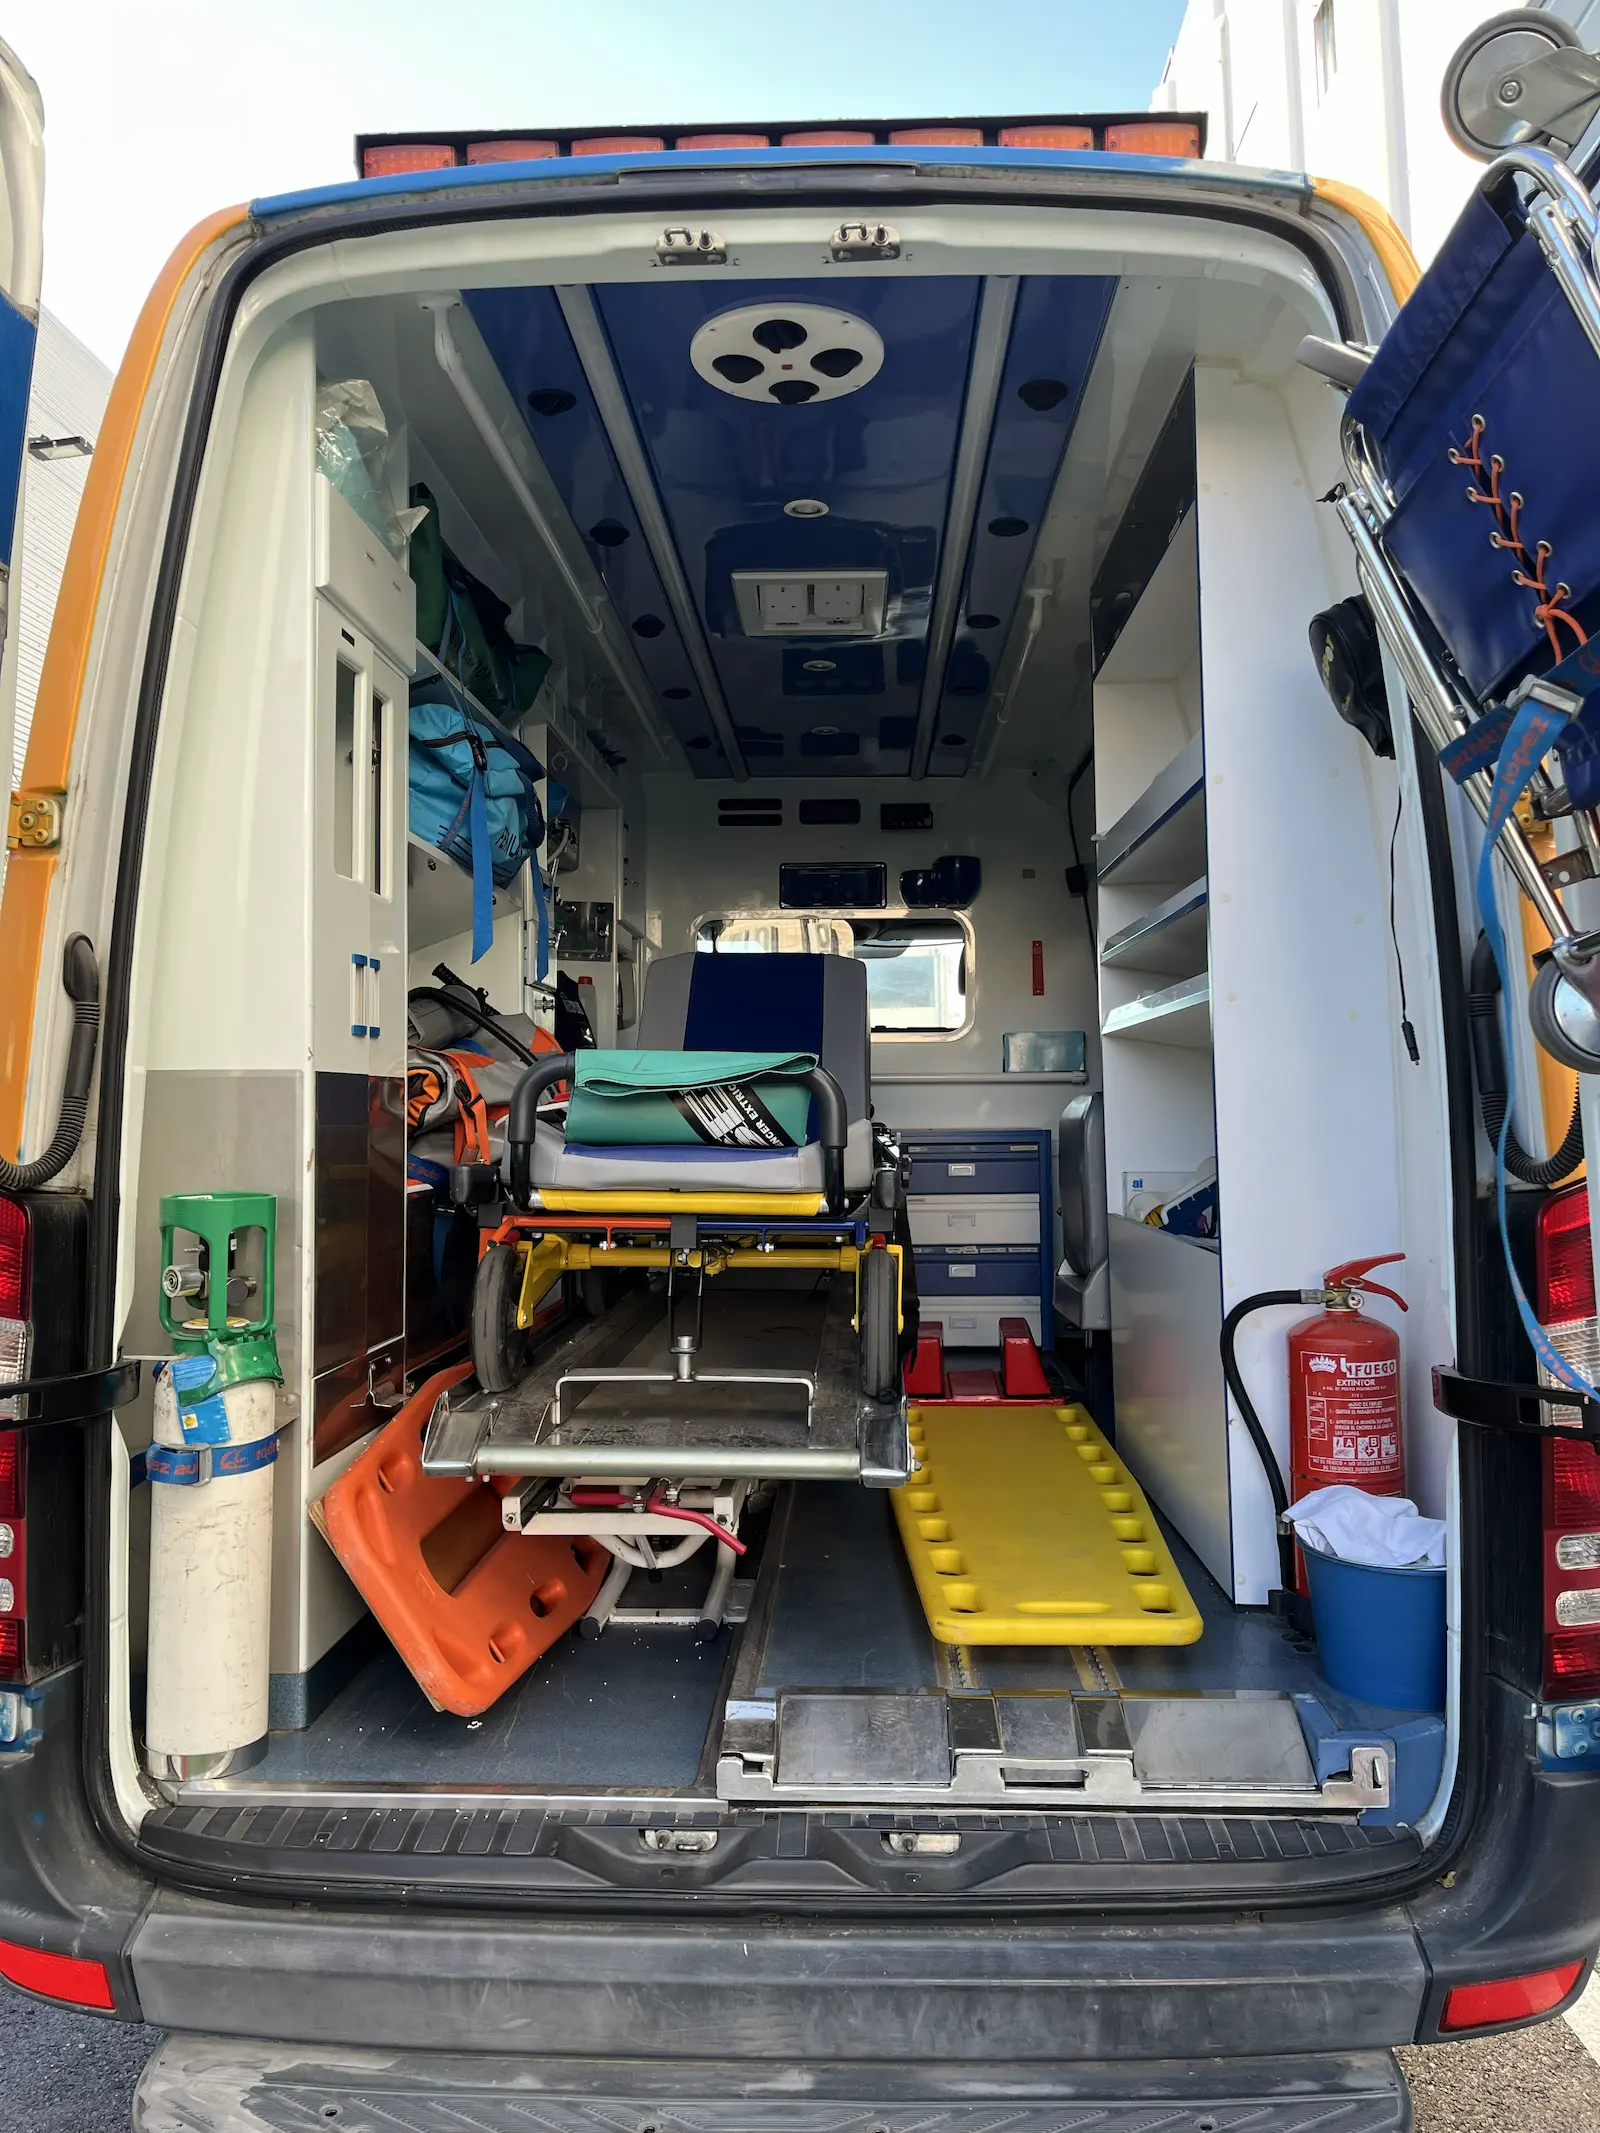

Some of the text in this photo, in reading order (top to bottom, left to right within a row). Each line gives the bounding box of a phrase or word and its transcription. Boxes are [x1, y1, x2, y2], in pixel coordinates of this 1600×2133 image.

[1336, 1379, 1376, 1387] EXTINTOR
[1345, 1438, 1353, 1447] A
[1371, 1438, 1377, 1446] B
